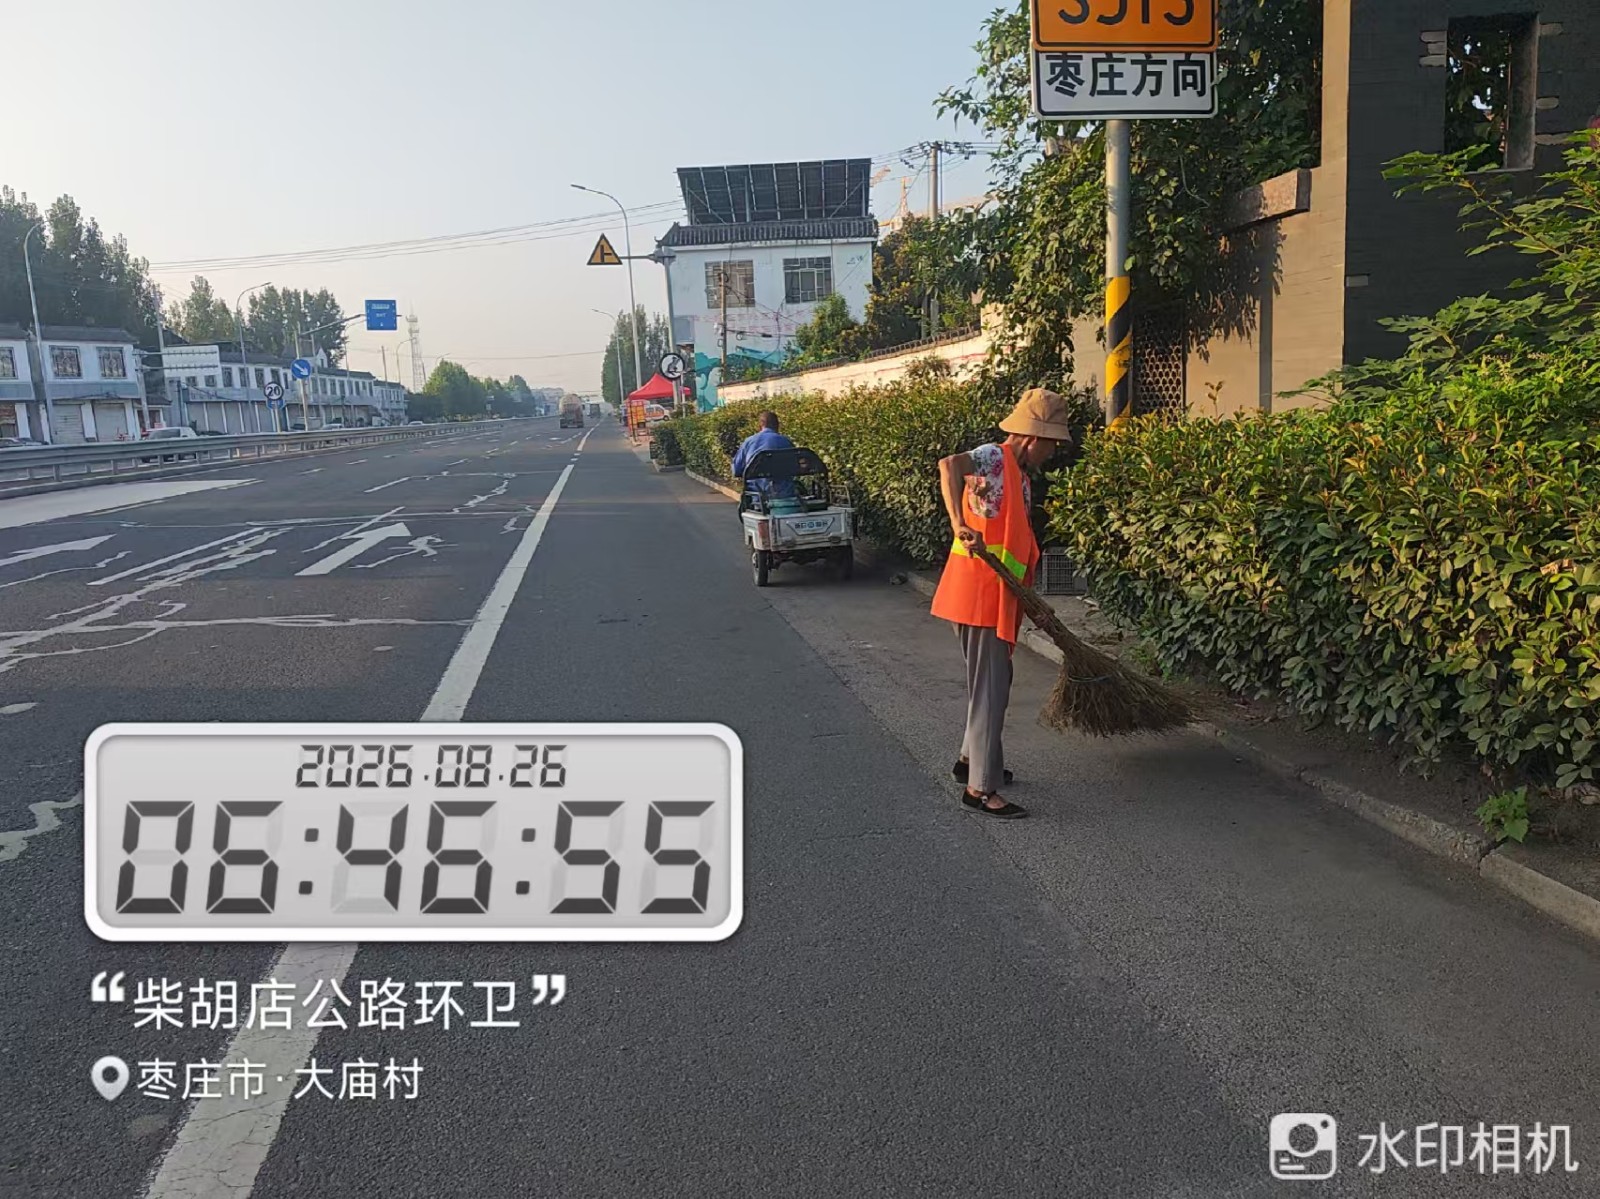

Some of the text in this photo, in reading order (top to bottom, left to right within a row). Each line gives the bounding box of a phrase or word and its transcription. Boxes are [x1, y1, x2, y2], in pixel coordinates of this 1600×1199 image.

[1045, 52, 1206, 98] 枣庄方向
[267, 386, 280, 397] 20
